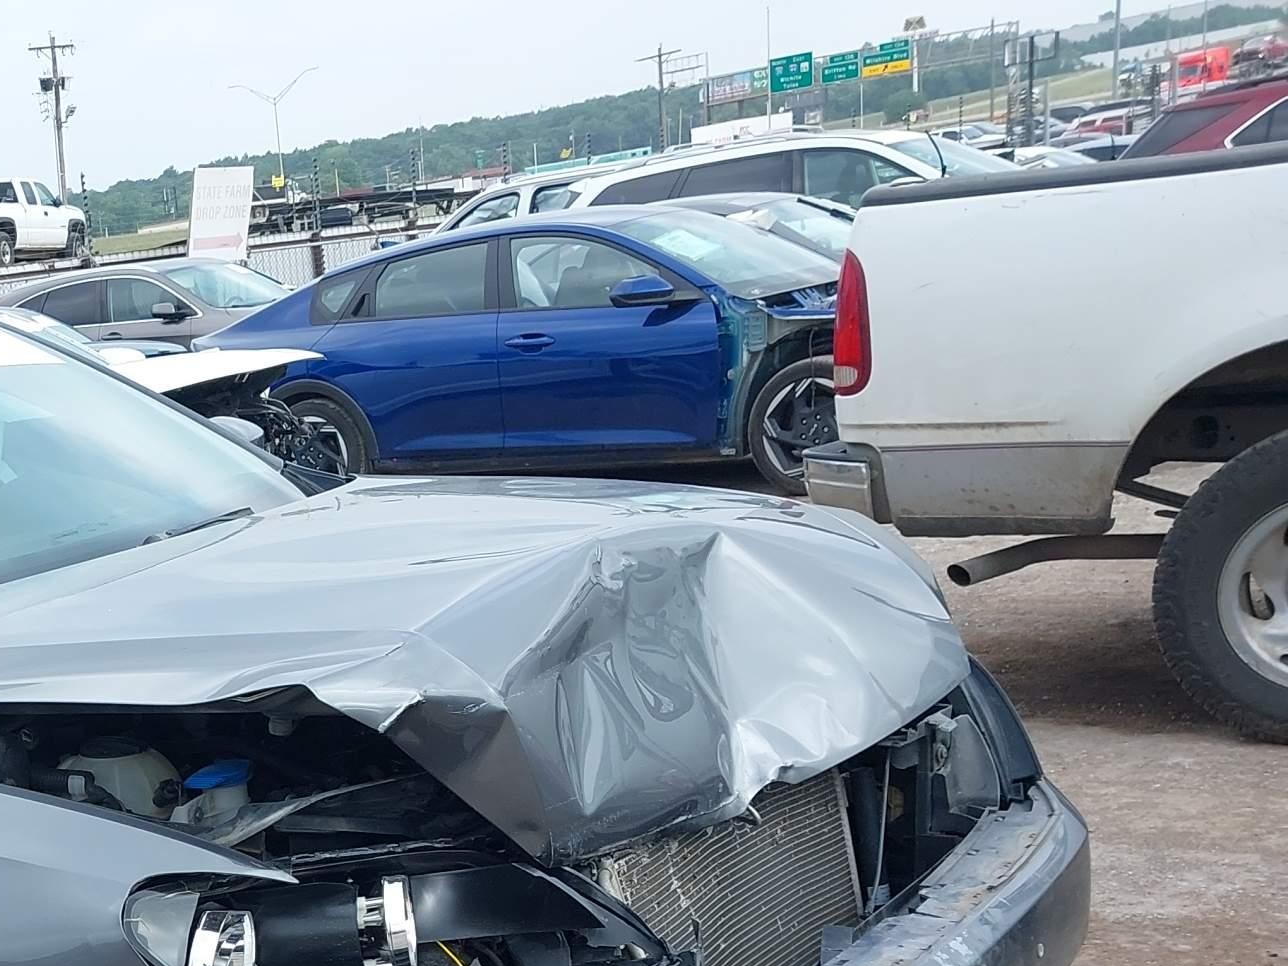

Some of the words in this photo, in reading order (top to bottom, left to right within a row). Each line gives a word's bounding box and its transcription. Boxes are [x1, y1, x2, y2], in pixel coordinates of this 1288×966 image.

[196, 186, 223, 200] STATE
[224, 183, 251, 198] FARM
[196, 206, 221, 220] DROP
[223, 205, 247, 219] ZONE
